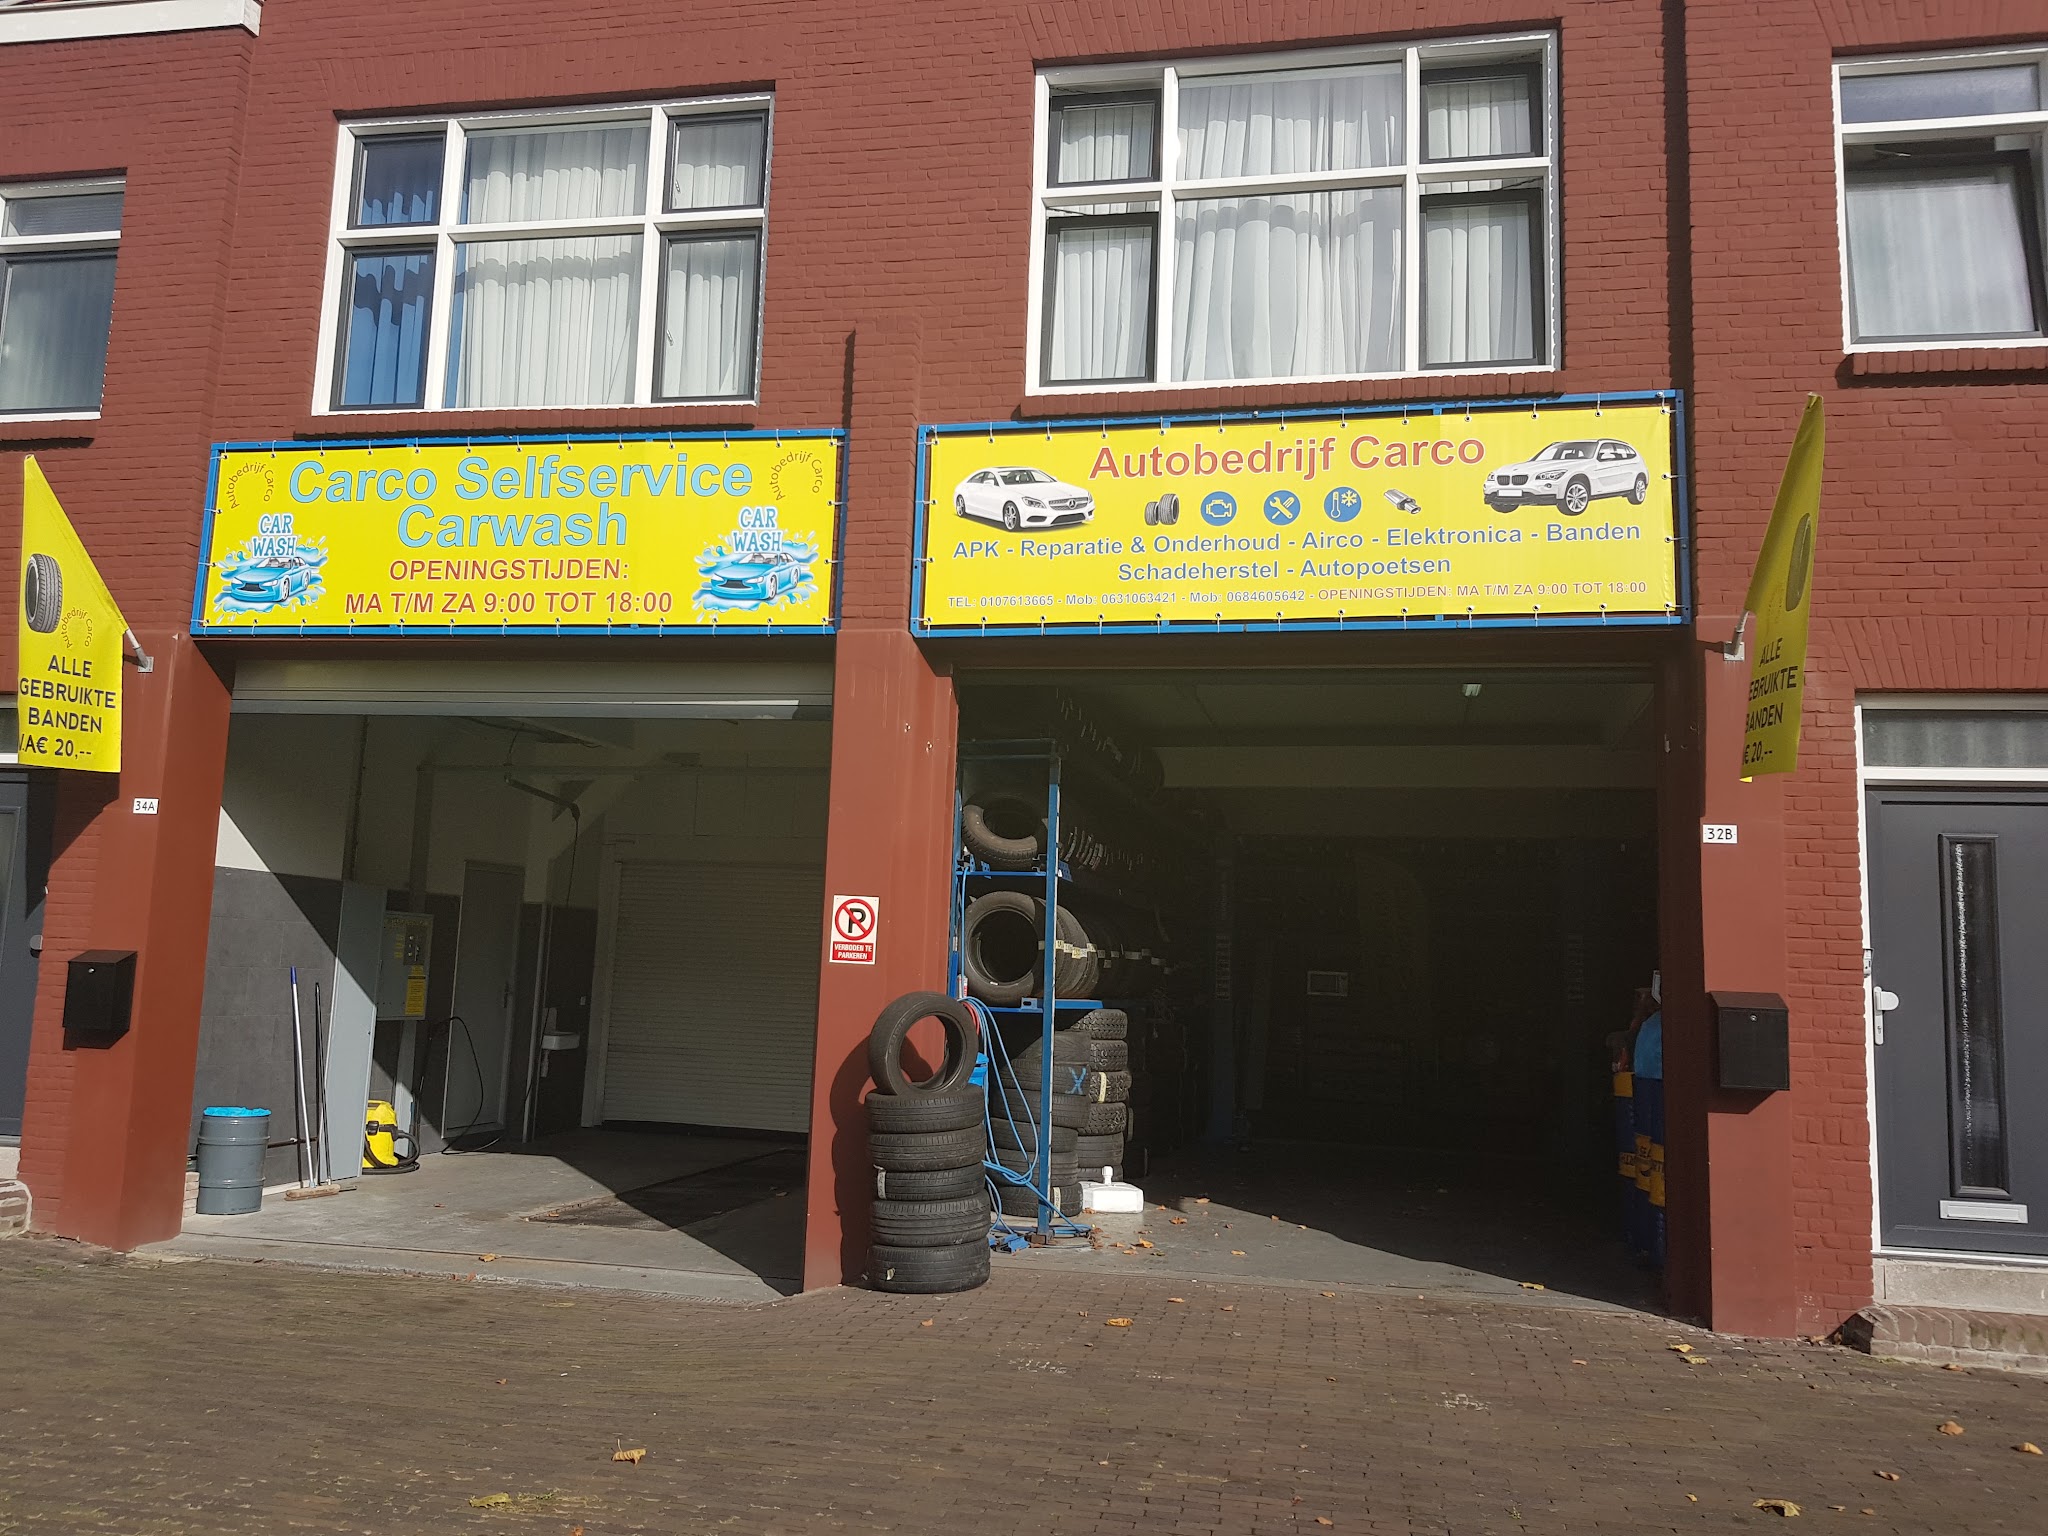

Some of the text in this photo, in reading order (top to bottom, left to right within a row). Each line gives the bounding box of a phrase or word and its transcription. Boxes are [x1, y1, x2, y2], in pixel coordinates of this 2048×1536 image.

[1089, 435, 1485, 480] Autobedrijf Carco
[225, 461, 275, 509] Autobedrijf Carco
[289, 453, 753, 503] Carco Selfservice
[769, 449, 823, 501] Autobedrijf Carco
[259, 514, 293, 534] CAR
[397, 501, 627, 548] Carwash
[740, 508, 777, 528] CAR
[252, 536, 298, 557] WASH
[733, 531, 783, 552] WASH
[953, 541, 1000, 559] APK
[1020, 537, 1123, 560] Reparatie
[1130, 536, 1146, 554] &
[1153, 533, 1280, 554] Onderhoud
[1301, 530, 1364, 550] Airco
[1387, 525, 1522, 547] Elektronica
[1546, 523, 1640, 542] Banden
[389, 558, 630, 581] OPENINGSTIJDEN:
[1118, 561, 1279, 581] Schadeherstel
[1300, 556, 1451, 580] Autopoetsen
[345, 592, 672, 613] MA T/M ZA 9:00 TOT 18:00
[948, 597, 976, 608] TEL:
[980, 594, 1054, 607] 0107613665
[1066, 594, 1097, 606] Mob:
[1101, 592, 1176, 605] 0631063421
[1190, 591, 1222, 603] Mob:
[1226, 590, 1305, 602] 0684605642
[1318, 585, 1452, 601] OPENINGSTIJDEN:
[1457, 585, 1479, 596] MA
[1483, 584, 1510, 596] T/M
[1514, 584, 1534, 596] ZA
[1537, 583, 1568, 595] 9:00
[1572, 582, 1603, 594] TOT
[1608, 581, 1647, 594] 18:00
[61, 606, 88, 648] Autobedrijf
[1758, 637, 1783, 668] ALLE
[47, 654, 93, 678] ALLE
[19, 677, 117, 709] GEBRUIKTE
[1748, 665, 1798, 701] EBRUIKTE
[28, 707, 103, 734] BANDEN
[135, 800, 156, 812] 34A
[1707, 828, 1734, 840] 32B
[834, 943, 864, 952] VERBODEN
[838, 952, 867, 960] PARKEREN
